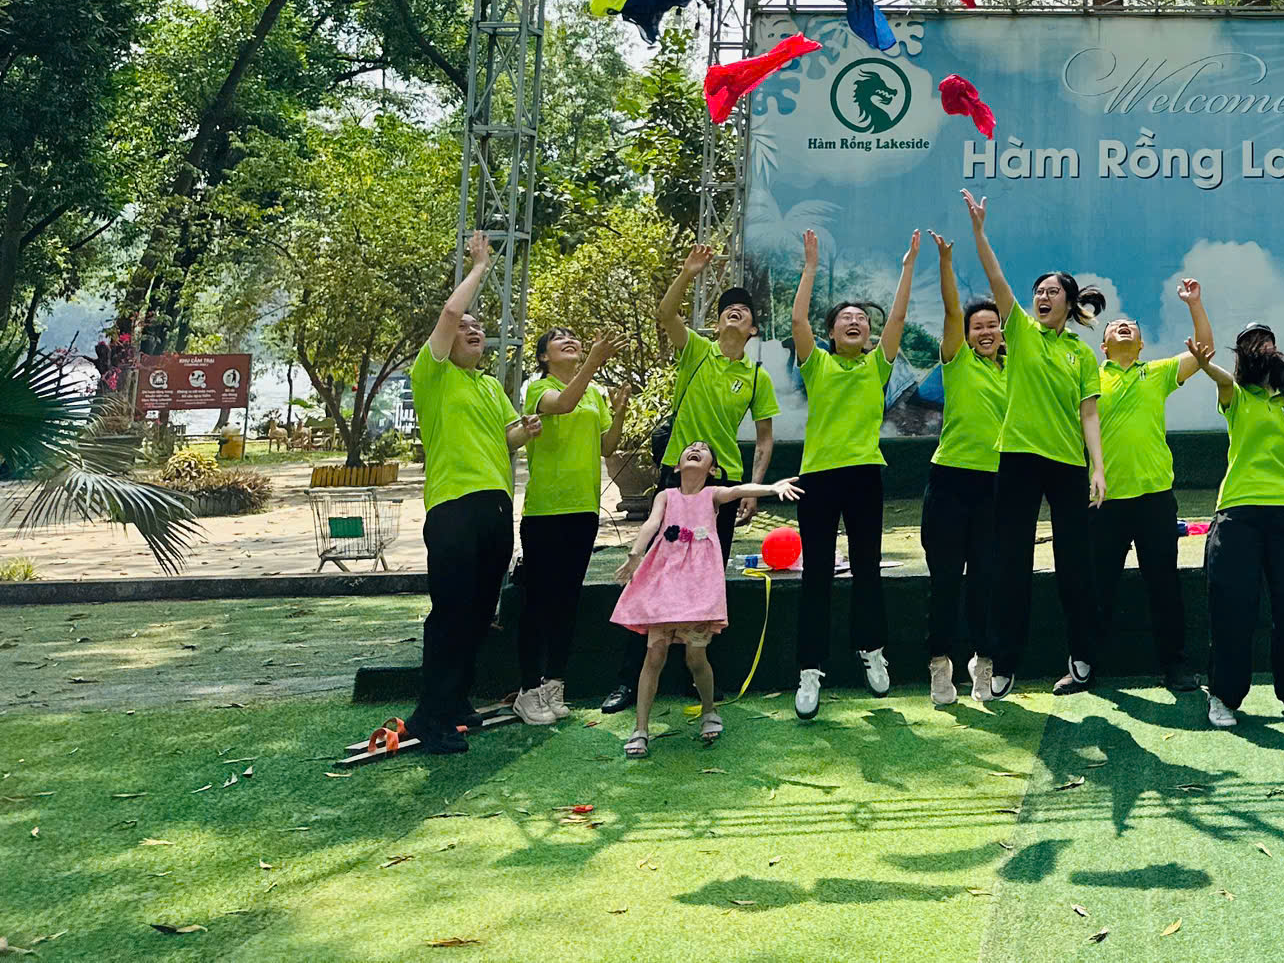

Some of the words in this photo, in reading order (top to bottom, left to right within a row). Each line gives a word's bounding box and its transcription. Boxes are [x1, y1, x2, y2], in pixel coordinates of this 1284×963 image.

[808, 138, 836, 150] Hàm
[876, 138, 930, 150] Lakeside
[963, 135, 1080, 180] Hàm
[1099, 126, 1224, 191] Rồng
